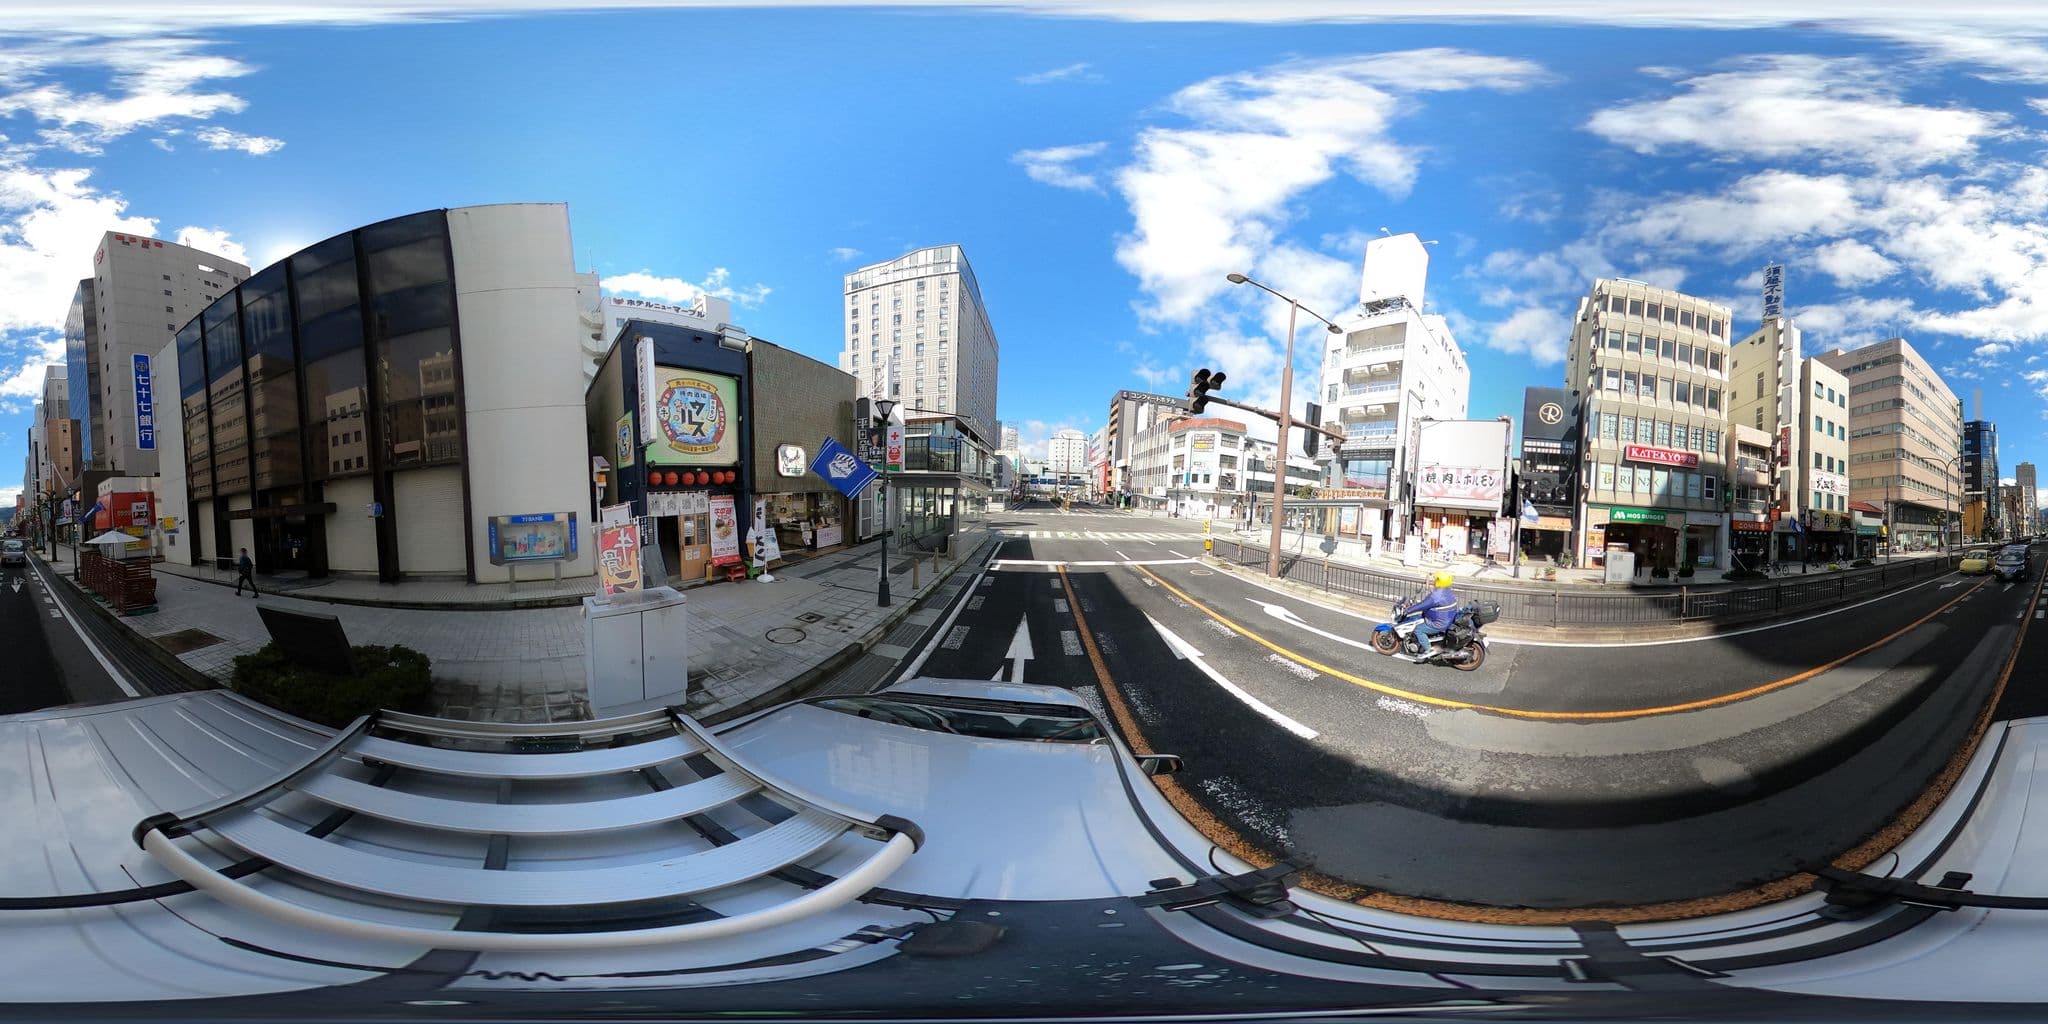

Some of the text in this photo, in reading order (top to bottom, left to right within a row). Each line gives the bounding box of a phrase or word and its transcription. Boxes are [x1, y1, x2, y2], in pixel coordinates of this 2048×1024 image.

[136, 374, 153, 440] 七十七銀行
